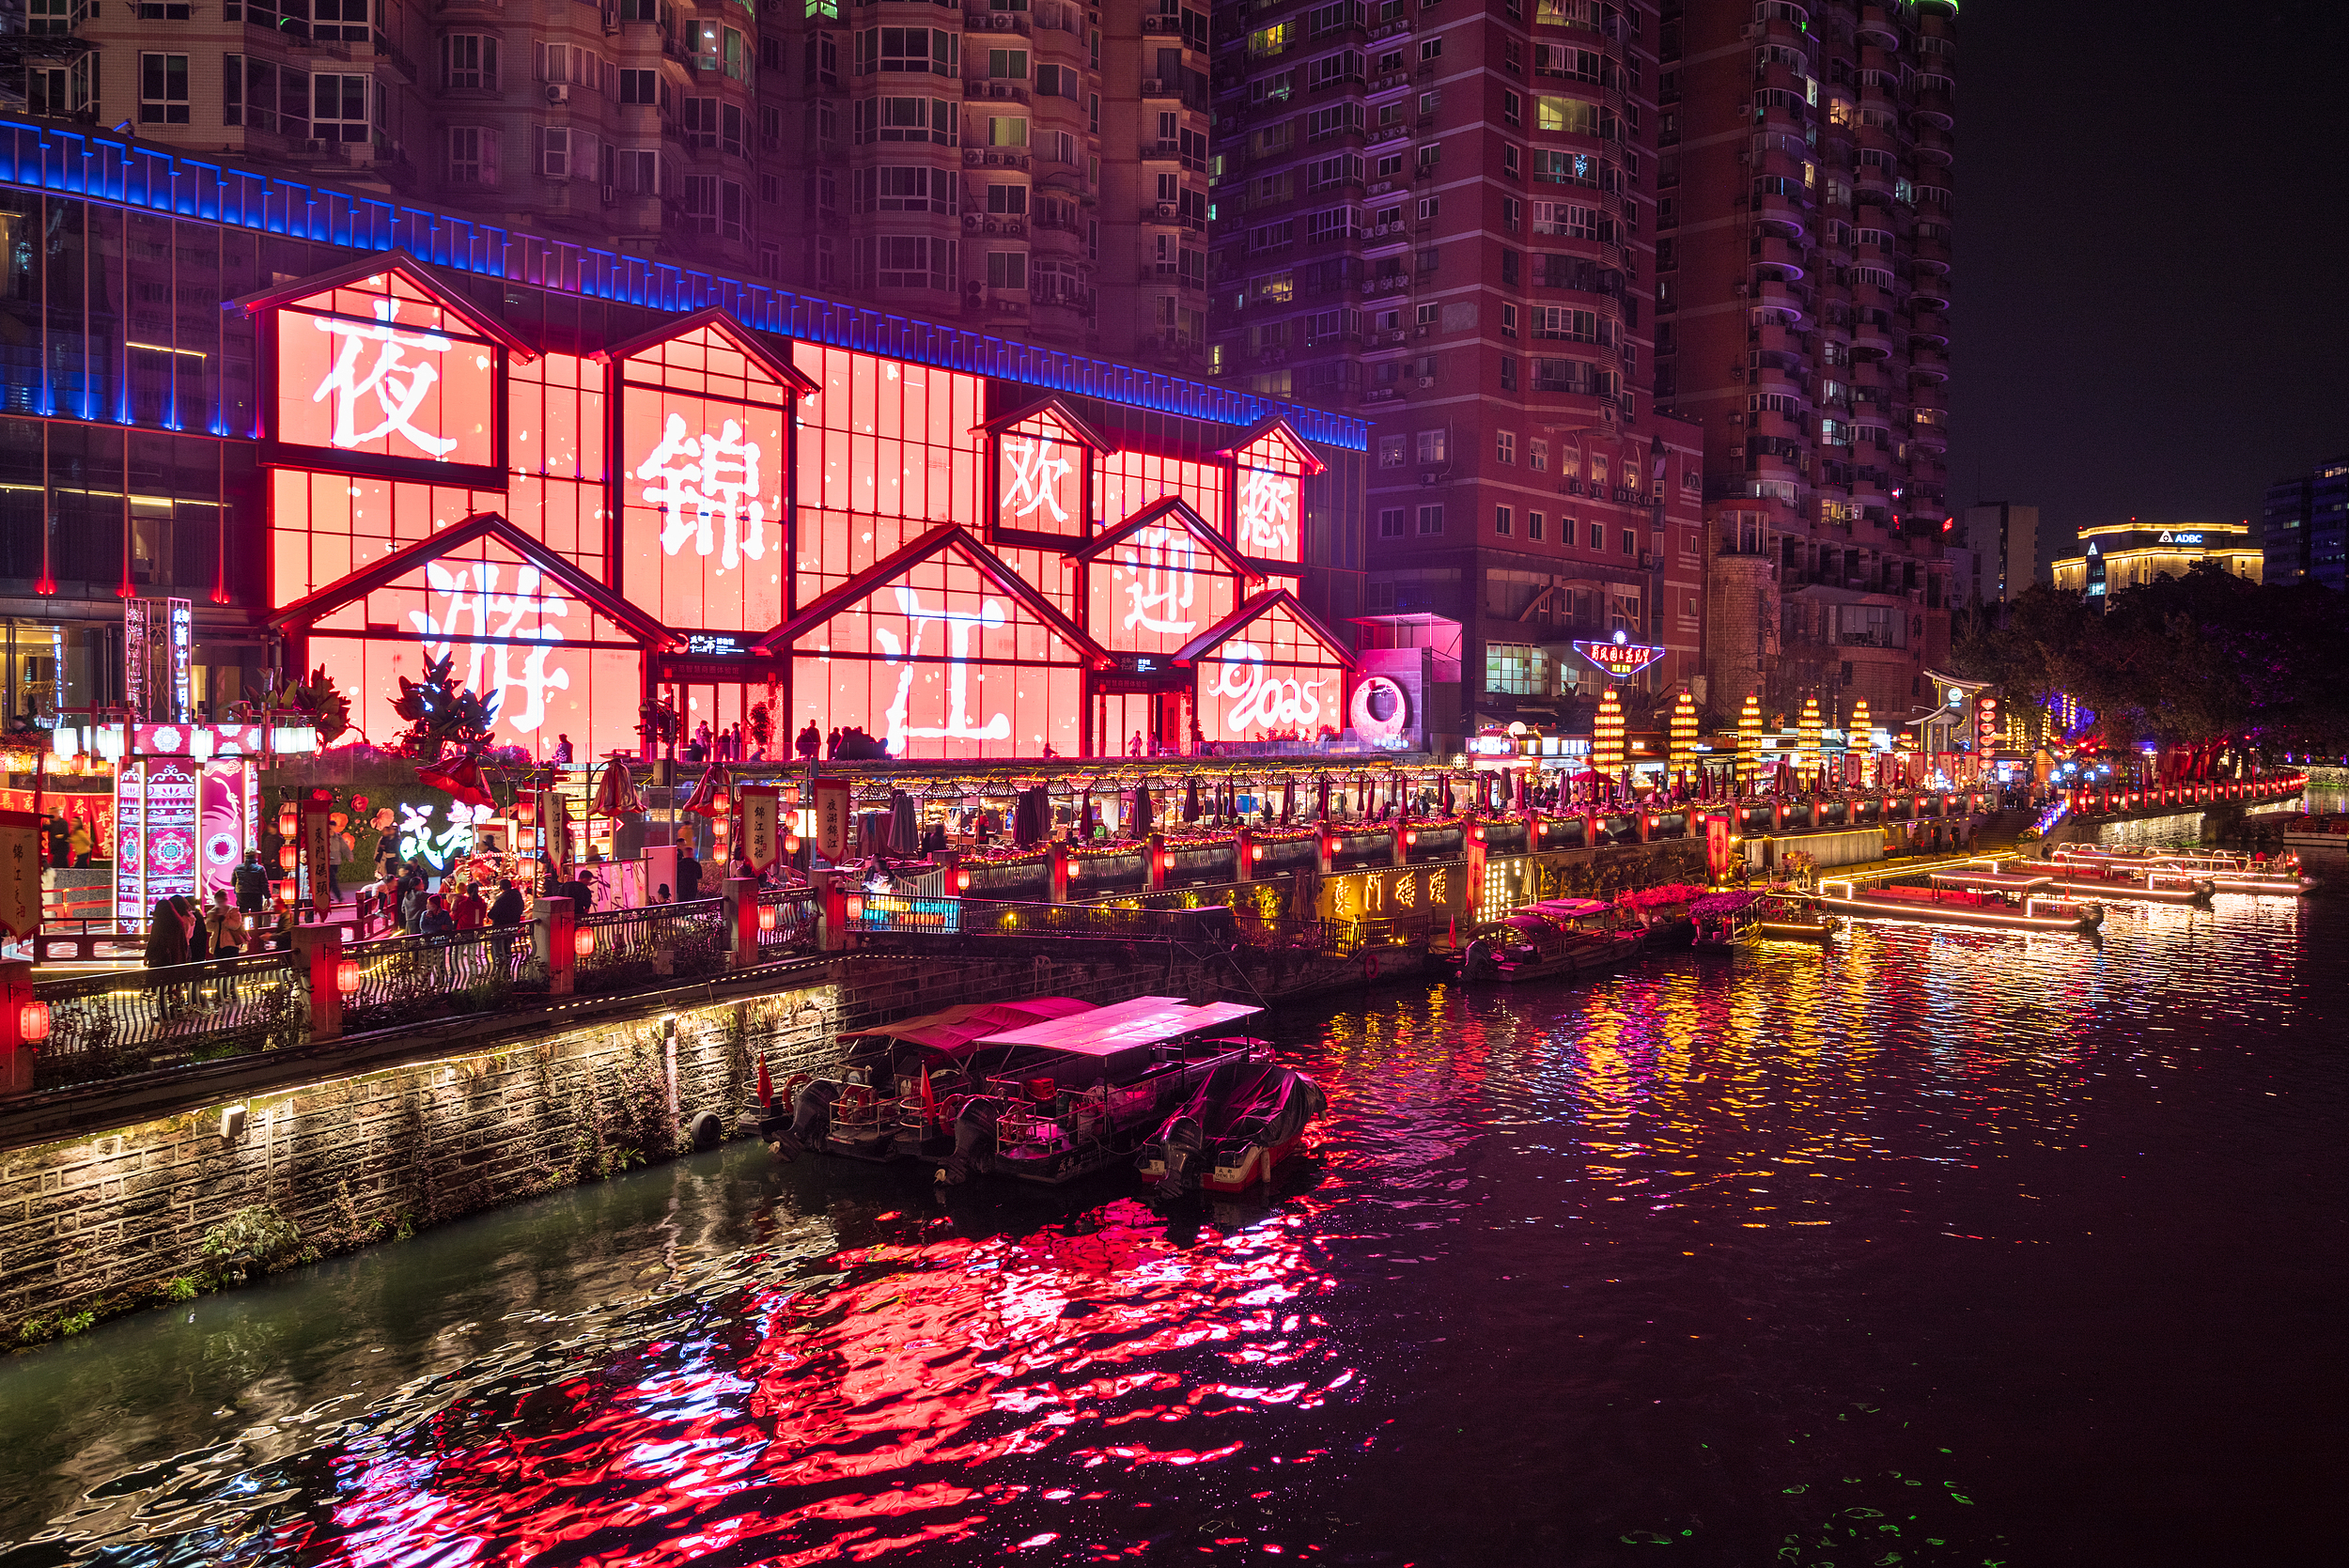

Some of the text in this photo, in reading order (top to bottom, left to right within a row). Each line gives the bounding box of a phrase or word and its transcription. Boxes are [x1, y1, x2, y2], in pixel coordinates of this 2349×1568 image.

[312, 299, 458, 460] 夜
[636, 412, 766, 570] 锦
[1002, 435, 1070, 523] 欢
[1240, 466, 1294, 550] 您
[1124, 527, 1197, 634] 迎
[2174, 534, 2202, 544] ADBC
[408, 561, 569, 733] 游
[657, 663, 739, 675] 国示范智慧商圈体验馆
[876, 586, 1011, 755] 江
[1206, 641, 1324, 733] 2025
[1334, 868, 1447, 915] 東門碼頭
